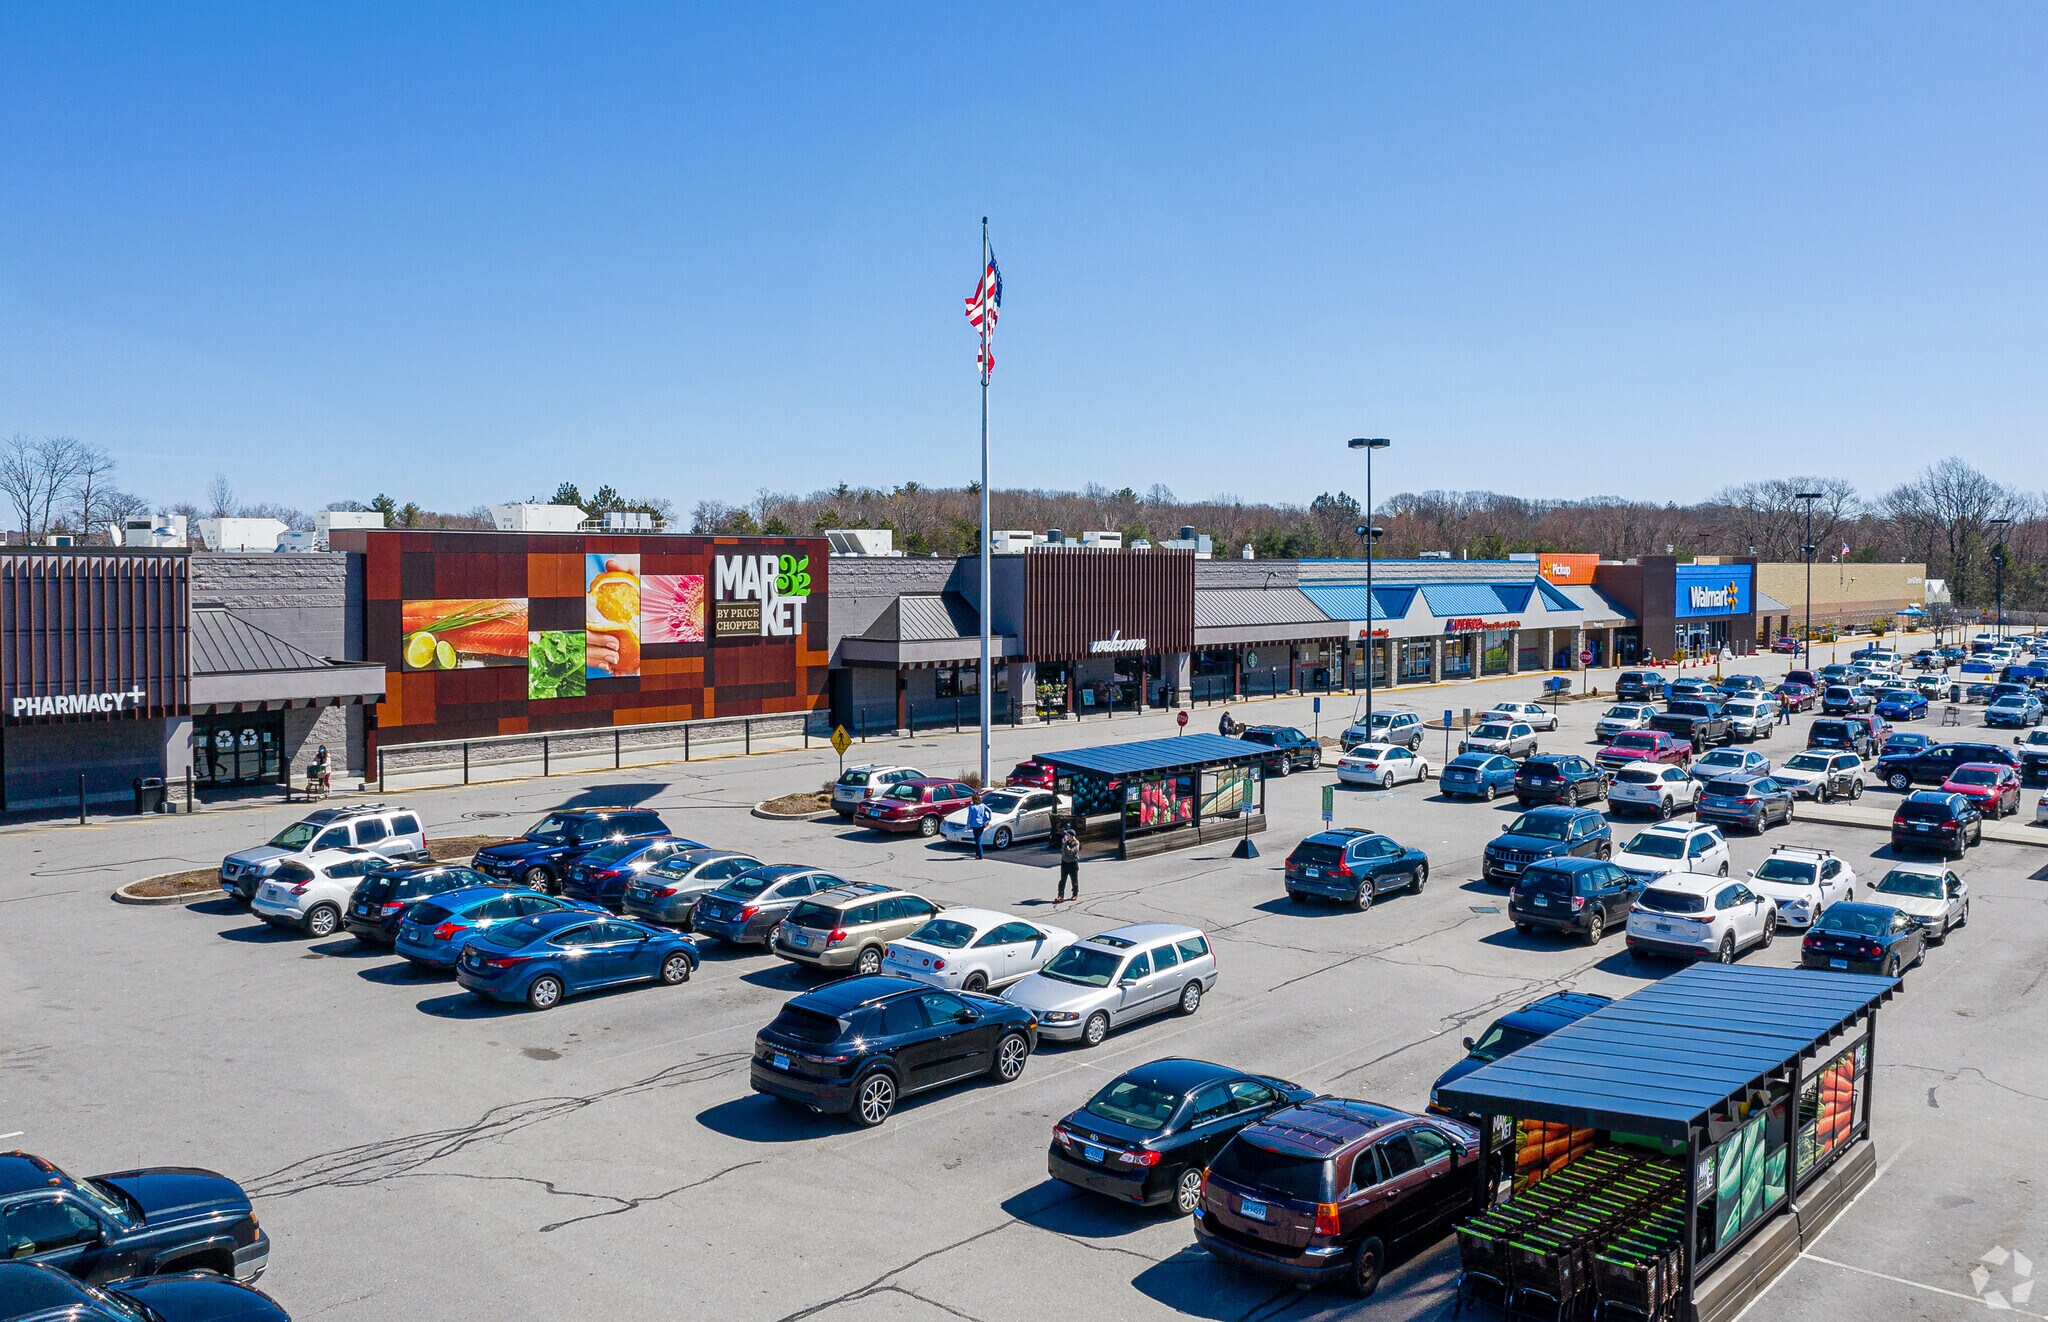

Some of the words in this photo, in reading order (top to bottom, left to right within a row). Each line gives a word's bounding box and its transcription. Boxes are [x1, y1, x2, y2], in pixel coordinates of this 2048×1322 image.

[1552, 563, 1571, 578] Pickup
[1690, 585, 1728, 608] Walmart
[716, 609, 729, 619] BY
[730, 608, 760, 618] PRICE
[716, 620, 760, 631] CHOPPER
[1090, 629, 1147, 653] welcome
[1177, 714, 1188, 722] STOP
